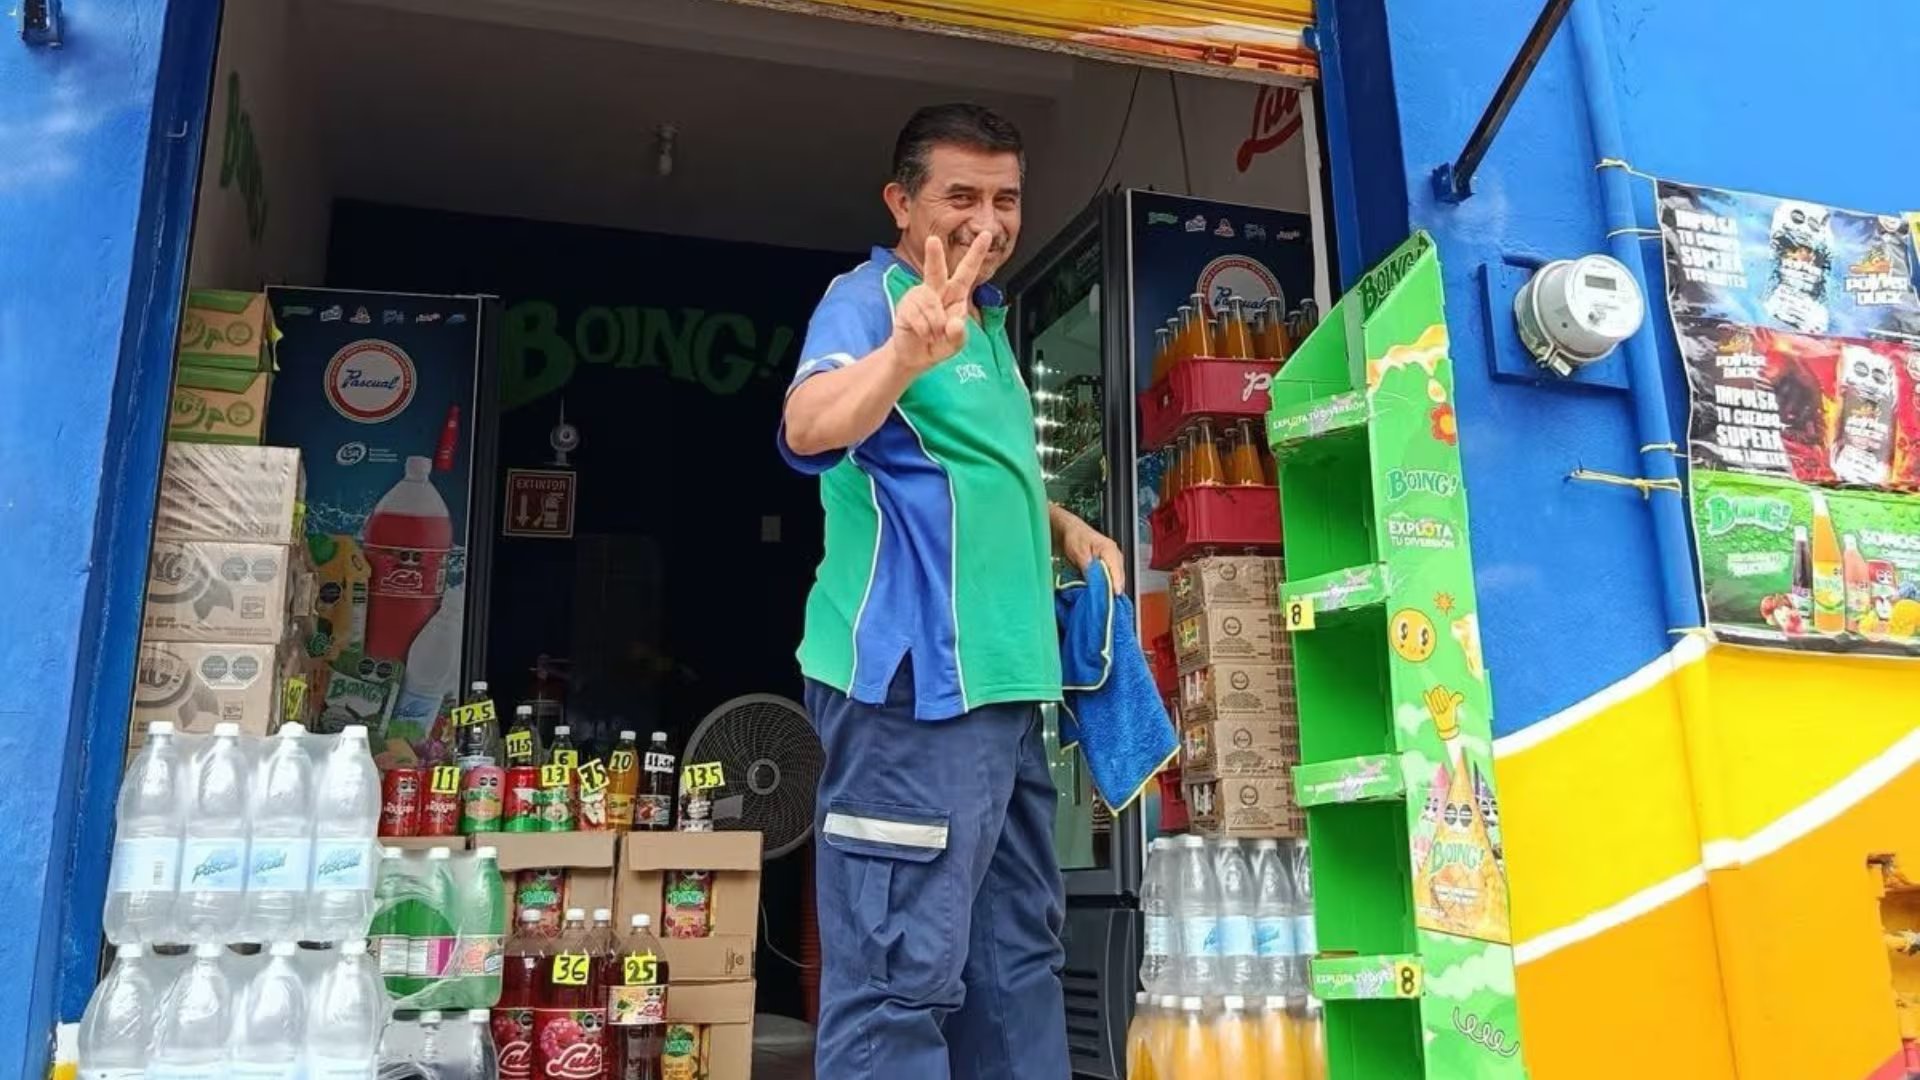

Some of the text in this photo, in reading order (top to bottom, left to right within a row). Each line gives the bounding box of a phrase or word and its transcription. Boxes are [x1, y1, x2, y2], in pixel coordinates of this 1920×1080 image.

[500, 300, 794, 411] BOING!
[342, 369, 401, 389] Pascual
[1714, 384, 1779, 411] IMPULSA
[1715, 405, 1780, 430] TU CUERPO
[1715, 424, 1787, 453] SUPERA
[516, 479, 566, 491] EXTINTOR
[1386, 469, 1458, 500] BOING!
[1388, 519, 1454, 538] EXPLOTA
[1391, 536, 1404, 546] TU
[1292, 604, 1302, 626] 8
[454, 703, 491, 726] 12.5
[612, 754, 632, 770] 10
[436, 767, 455, 791] 11
[546, 767, 566, 783] 13
[687, 766, 721, 788] 13.5
[556, 957, 587, 981] 36
[626, 959, 658, 981] 25
[1401, 966, 1415, 994] 8
